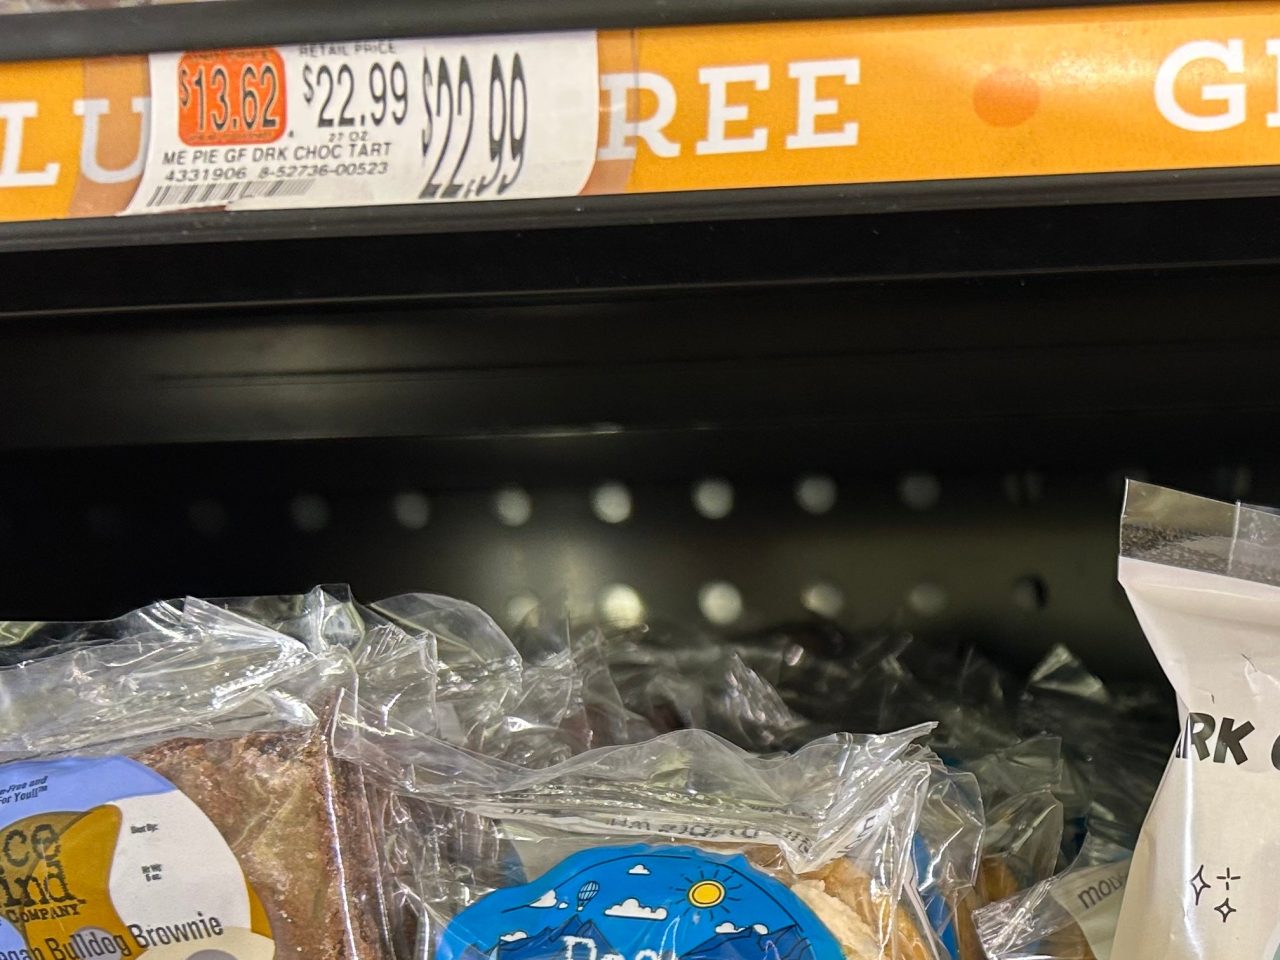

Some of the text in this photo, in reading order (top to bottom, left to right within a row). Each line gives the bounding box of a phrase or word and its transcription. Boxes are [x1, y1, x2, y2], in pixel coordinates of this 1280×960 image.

[179, 64, 280, 131] $13.62
[302, 61, 408, 128] $22.99
[418, 48, 527, 199] $22.99
[162, 142, 393, 166] ME PIE GF DRK CHOC TART
[165, 162, 389, 182] 4331906 8-52736-00523
[1176, 712, 1256, 766] RK
[128, 911, 224, 950] Brownie
